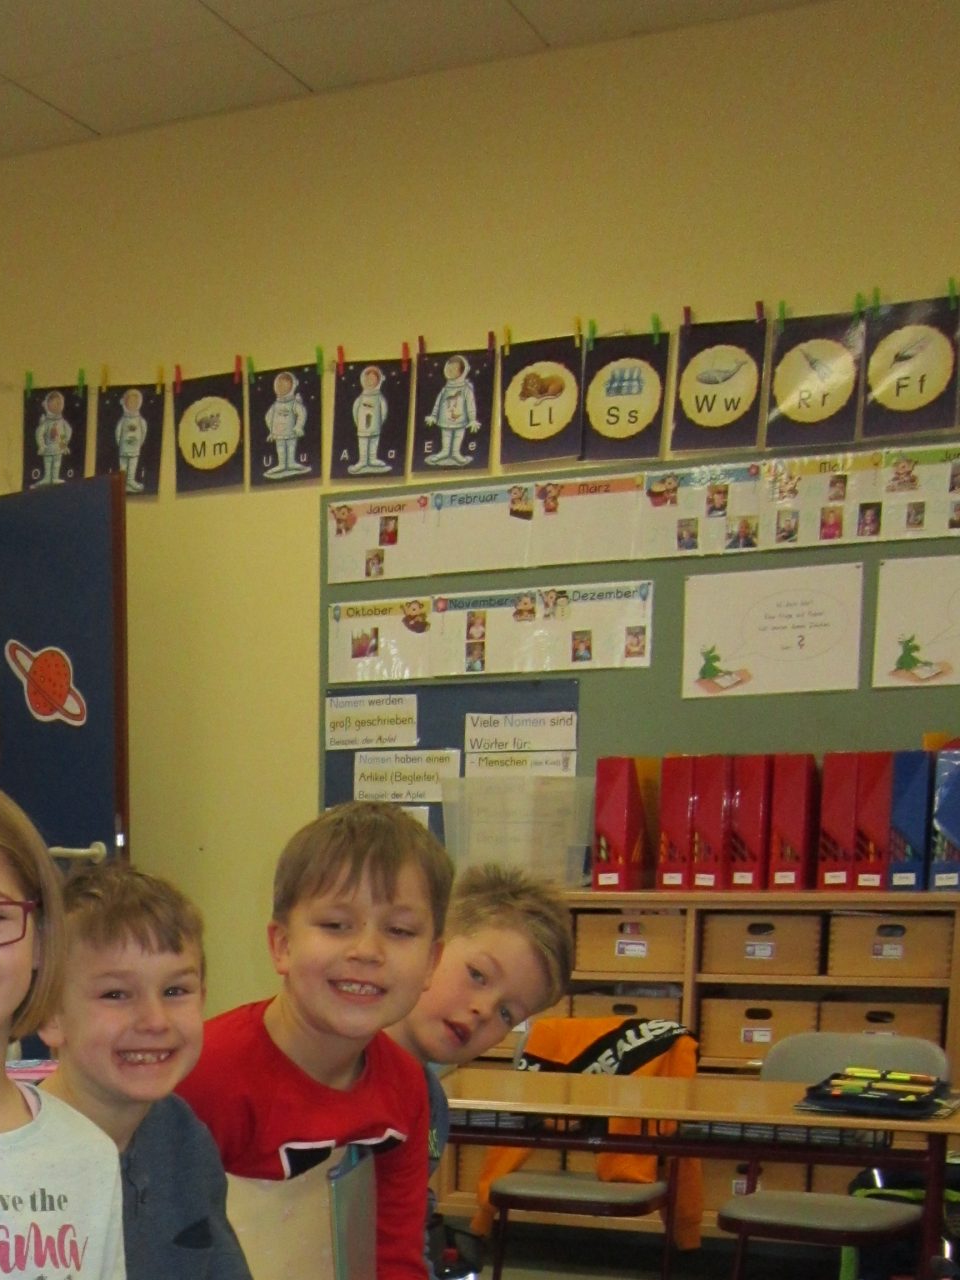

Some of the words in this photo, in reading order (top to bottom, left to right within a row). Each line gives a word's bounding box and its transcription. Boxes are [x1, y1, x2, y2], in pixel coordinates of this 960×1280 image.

[895, 376, 909, 397] F
[919, 374, 927, 394] f
[695, 394, 716, 413] W
[724, 397, 741, 412] w
[798, 390, 810, 409] R
[821, 391, 830, 407] r
[529, 409, 540, 426] L
[606, 407, 619, 425] S
[626, 409, 639, 424] s
[191, 441, 207, 459] M
[212, 441, 229, 455] m
[424, 441, 433, 453] E
[468, 441, 477, 452] e
[263, 456, 271, 467] U
[300, 453, 307, 463] u
[339, 450, 349, 461] A
[387, 449, 396, 459] a
[32, 468, 40, 480] O
[450, 492, 500, 506] Februar
[366, 502, 407, 515] Januar
[572, 588, 639, 601] Dezember
[448, 597, 510, 610] November
[346, 606, 393, 618] Oktober
[329, 697, 365, 709] Nomen
[367, 695, 403, 708] werden
[470, 715, 499, 729] Viele
[503, 715, 546, 729] Nomen
[549, 713, 573, 727] sind
[469, 736, 508, 751] Wörter
[394, 752, 423, 765] haben
[425, 754, 451, 764] einen
[478, 756, 528, 768] Menschen
[358, 771, 388, 783] Artikel
[29, 1187, 69, 1212] the
